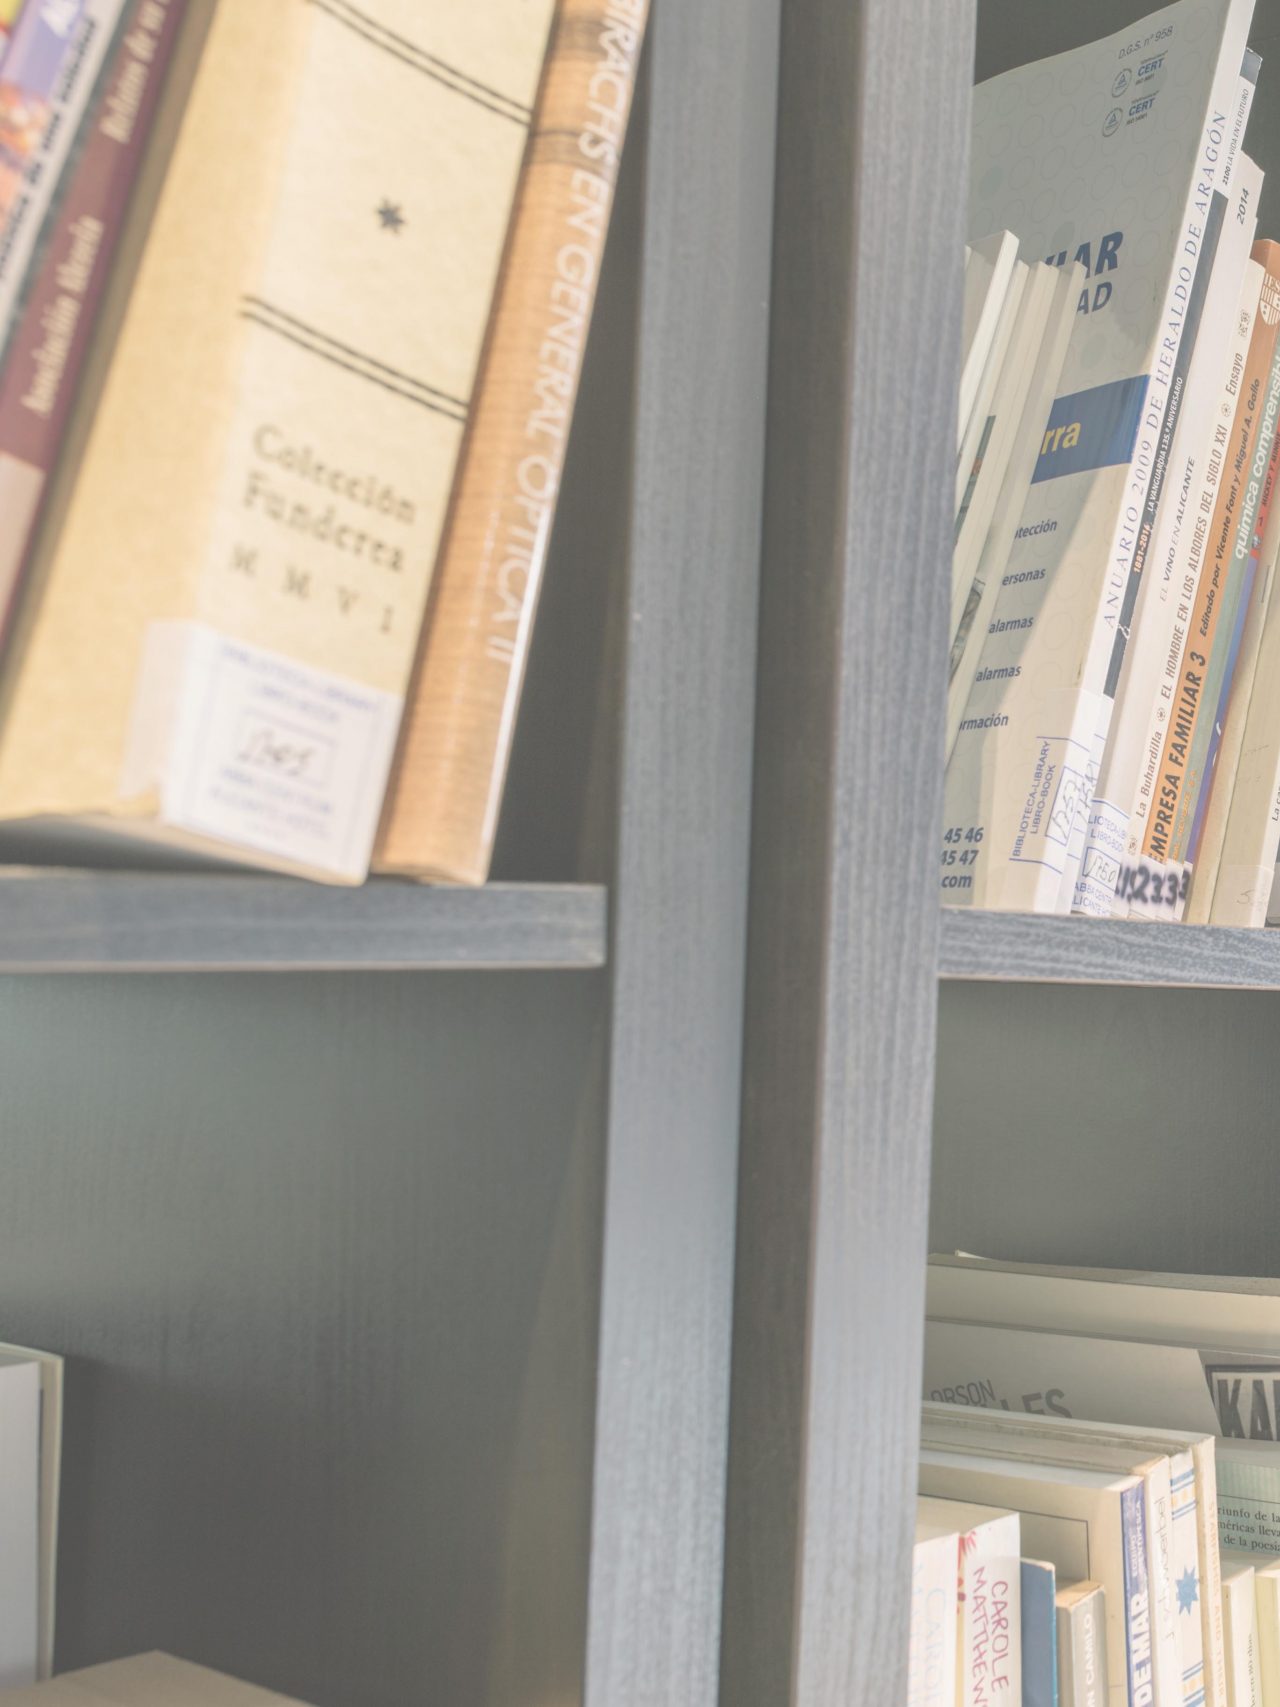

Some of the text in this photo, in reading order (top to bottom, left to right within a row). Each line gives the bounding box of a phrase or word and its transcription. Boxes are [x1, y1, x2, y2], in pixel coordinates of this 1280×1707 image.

[577, 0, 648, 168] IRACHS
[1137, 57, 1164, 77] CERT
[1129, 98, 1155, 116] CERT
[1222, 166, 1231, 184] 2100
[1238, 89, 1249, 118] FUTURO
[568, 170, 609, 237] EN
[1237, 188, 1249, 225] 2014
[526, 244, 597, 438] GENERAL
[1104, 112, 1226, 628] ANUARIO 2009 DE HERALDO DE ARAGÓN
[1167, 377, 1183, 428] ANIVERSARIO
[1247, 379, 1260, 411] Gallo
[1235, 428, 1249, 472] Miguel
[252, 424, 416, 524] Colección
[1150, 452, 1167, 501] VANGUARDIA
[1147, 500, 1155, 511] LA
[1227, 485, 1238, 513] Font
[1159, 587, 1169, 602] EL
[1164, 548, 1176, 581] VINO
[1176, 457, 1195, 525] ALICANTE
[1216, 517, 1231, 559] Vicente
[1002, 568, 1045, 586] ersonas
[1135, 353, 1243, 818] La Buhardilla EL HOMBRE EN LOS ALBORES DEL SIGLO XXI Ensayo
[1212, 563, 1221, 590] por
[988, 616, 1033, 634] alarmas
[1200, 590, 1216, 637] Editado
[976, 664, 1021, 682] alarmas
[1190, 651, 1205, 667] 3
[1169, 671, 1202, 767] FAMILIAR
[1012, 741, 1050, 857] BIBLIOTECA-LIBRARY
[1030, 765, 1056, 834] LIBRO-BOOK
[1147, 774, 1181, 863] EMPRESA
[1272, 808, 1280, 821] La
[944, 827, 984, 843] 45 46
[959, 850, 979, 866] 47
[930, 1379, 996, 1406] ORSON
[1254, 1509, 1268, 1521] de
[1271, 1512, 1280, 1523] la
[1224, 1535, 1236, 1545] de
[1239, 1536, 1247, 1546] la
[972, 1566, 989, 1707] MATTHEW
[991, 1581, 1009, 1692] CAROLE
[1130, 1593, 1151, 1657] MAR
[1083, 1613, 1095, 1685] CAMILO
